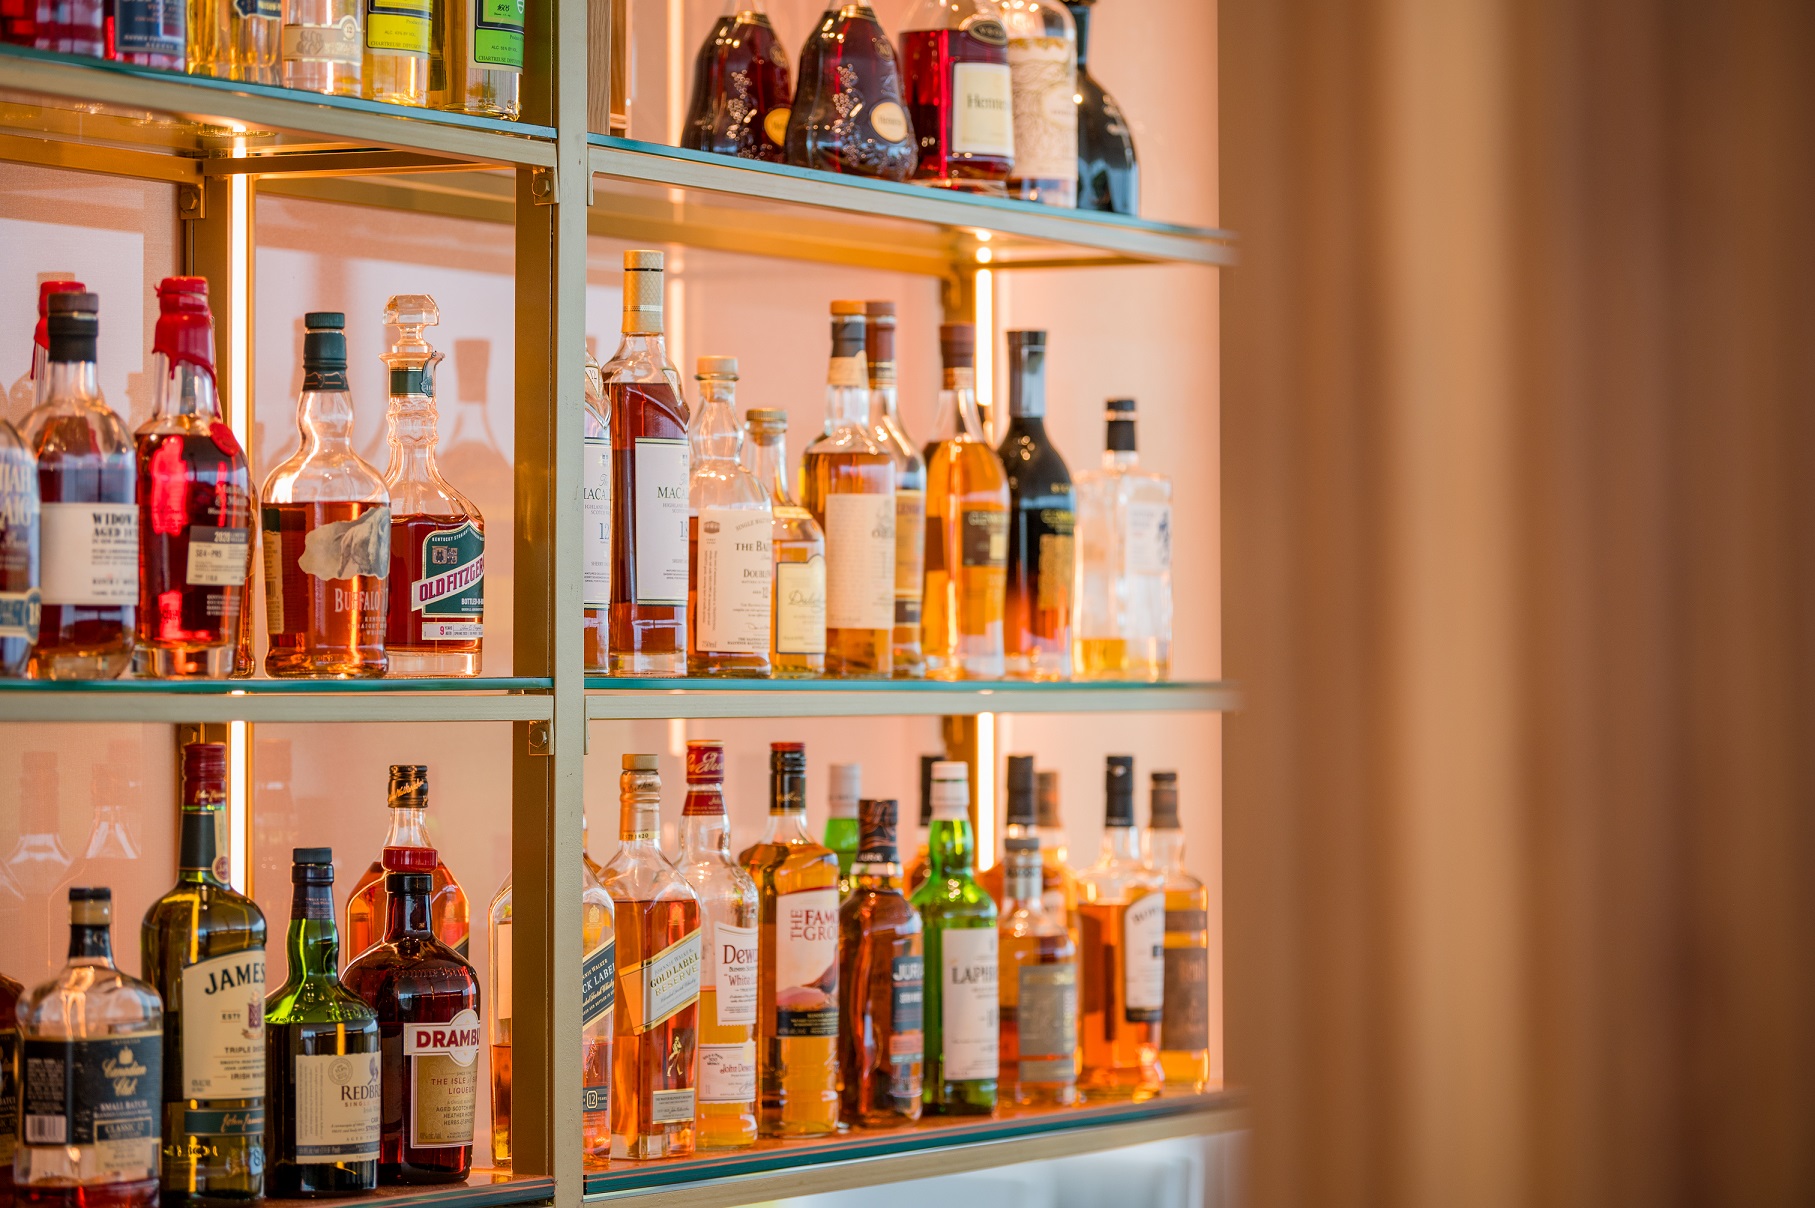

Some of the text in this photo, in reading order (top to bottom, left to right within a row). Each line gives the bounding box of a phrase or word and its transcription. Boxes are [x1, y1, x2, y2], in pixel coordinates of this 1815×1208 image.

[735, 542, 754, 552] THE
[419, 578, 446, 602] OLD
[334, 588, 380, 612] BUFFALO
[439, 625, 445, 636] 9
[790, 909, 803, 940] THE
[592, 958, 608, 972] WALKER
[650, 953, 699, 988] GOLD LABEL
[204, 962, 265, 995] JAMES
[655, 963, 697, 996] RESERVE
[224, 1046, 251, 1054] TRIPLE
[430, 1078, 448, 1086] THE
[451, 1077, 466, 1085] ISLE
[448, 1086, 475, 1095] LIQUEUR
[588, 1094, 596, 1105] 12
[100, 1100, 148, 1111] SMALL BATCH
[105, 1123, 134, 1134] CLASSIC
